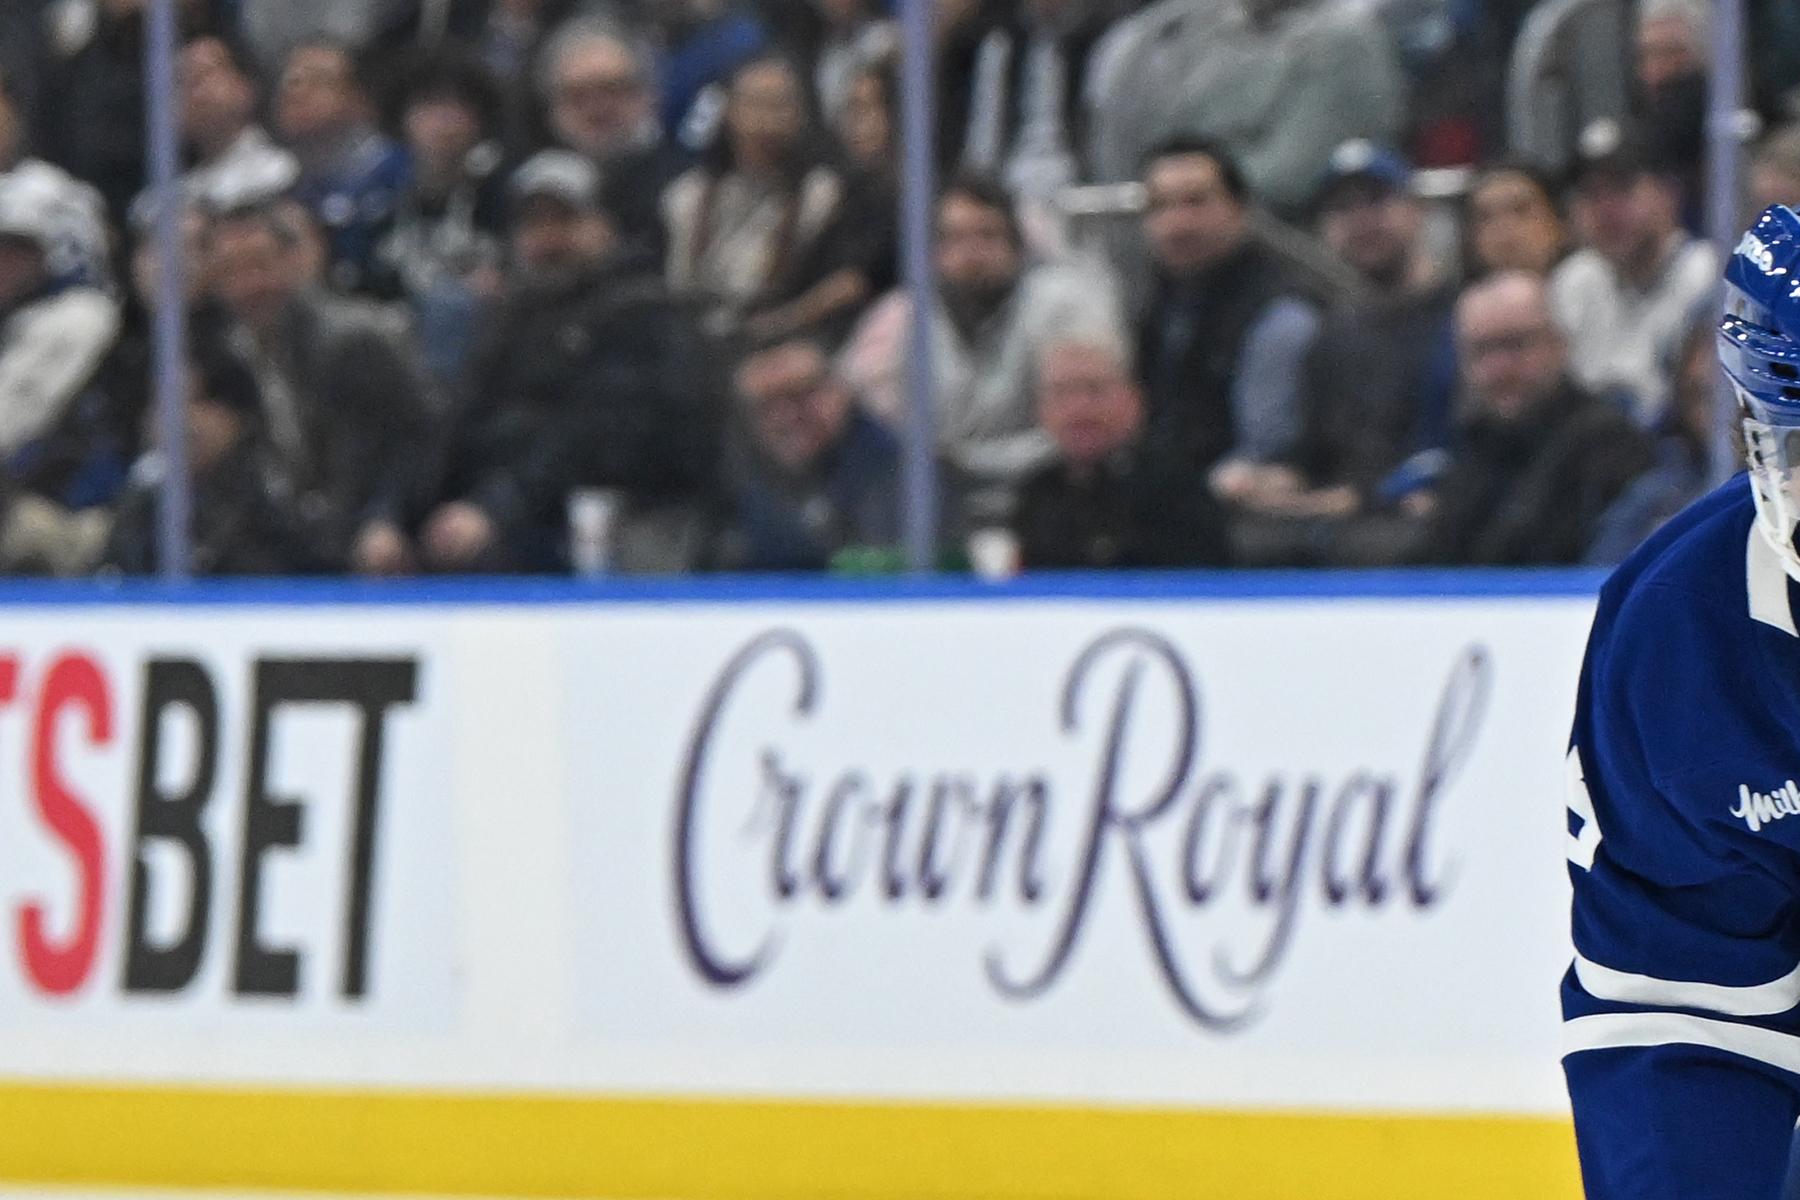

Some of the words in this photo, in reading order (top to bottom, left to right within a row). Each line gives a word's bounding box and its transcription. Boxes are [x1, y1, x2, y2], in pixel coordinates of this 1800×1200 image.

[0, 646, 423, 1001] SBET
[671, 627, 1047, 993] Crown
[983, 626, 1494, 1035] Royal
